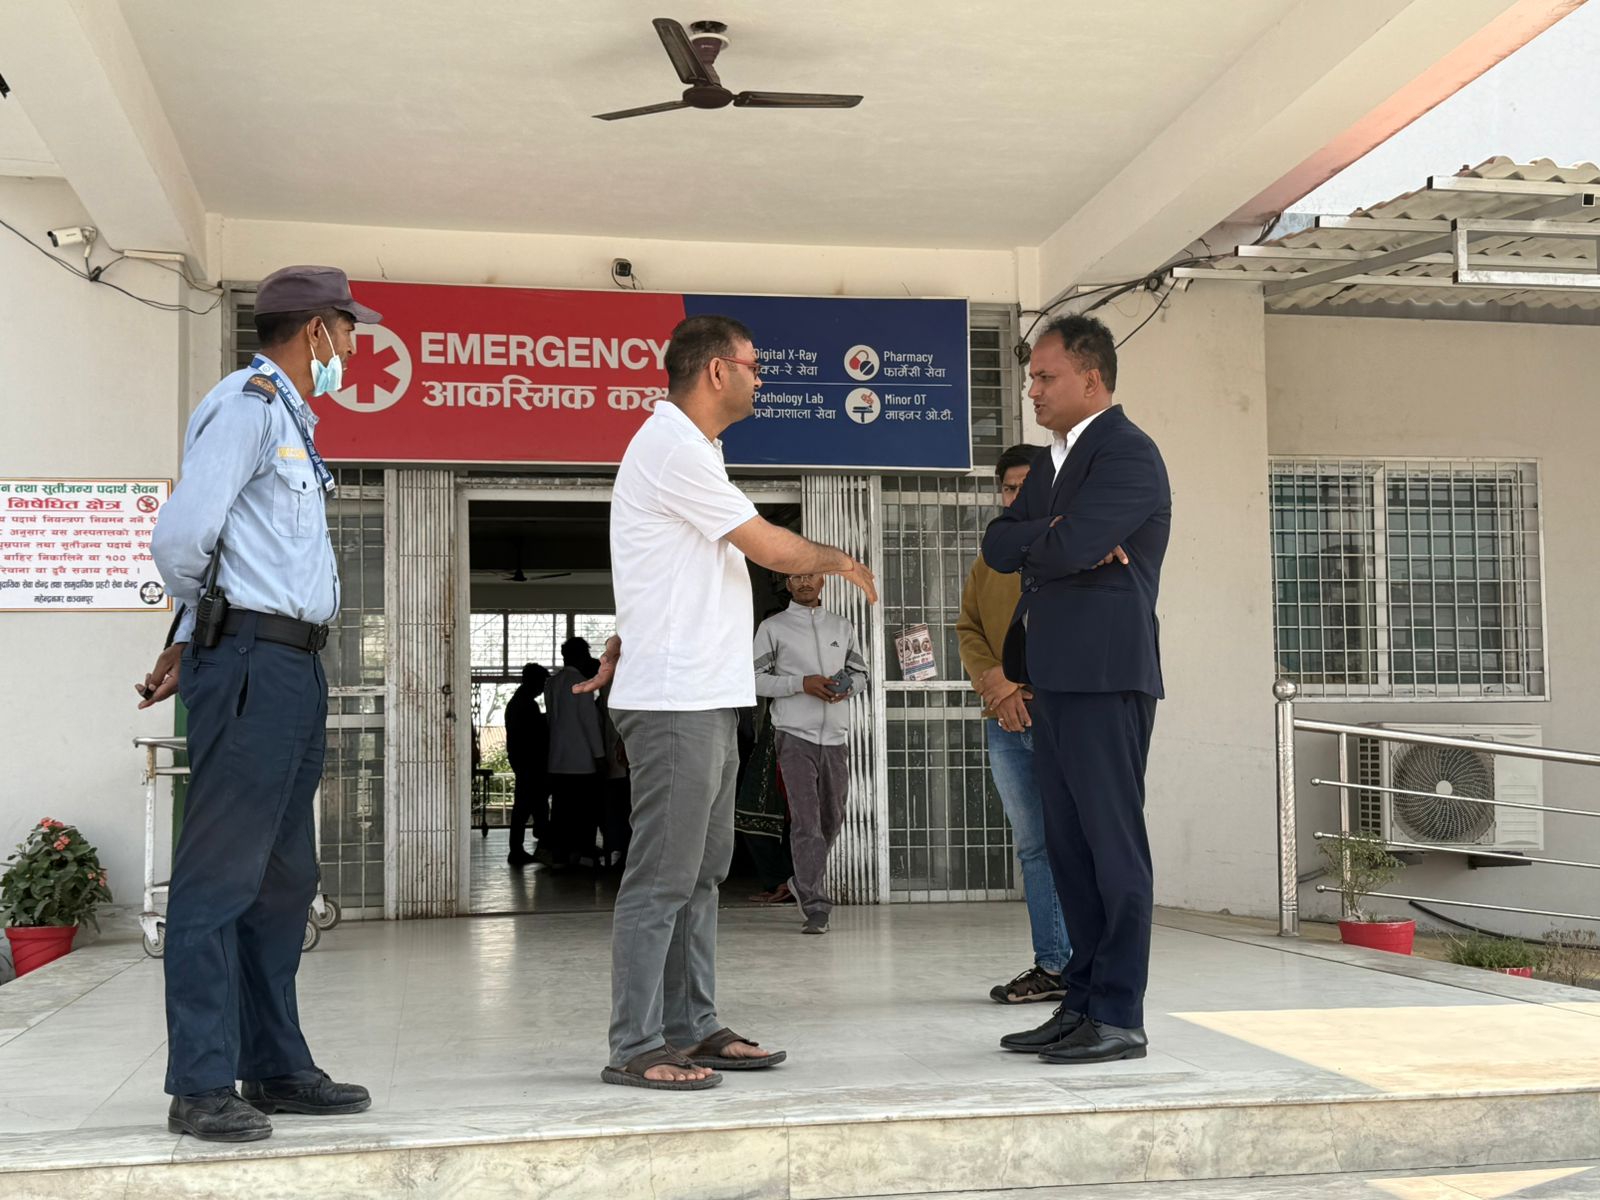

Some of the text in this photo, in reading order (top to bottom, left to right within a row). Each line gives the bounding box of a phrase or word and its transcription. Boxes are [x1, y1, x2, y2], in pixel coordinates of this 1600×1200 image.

[421, 332, 669, 370] EMERGENCY
[753, 348, 817, 362] Digital X-Ray
[884, 351, 933, 364] Pharmacy
[759, 362, 818, 376] क्स-रे सेवा
[884, 365, 946, 378] फार्मेसी सेवा
[422, 375, 598, 411] आकस्मिक
[754, 391, 824, 406] Pathology Lab
[885, 393, 927, 405] Minor OT
[754, 406, 836, 419] प्रयोगशाला सेवा
[885, 407, 954, 422] माइनर ओ.टी.
[15, 484, 37, 493] तथा
[131, 483, 159, 494] सेवन
